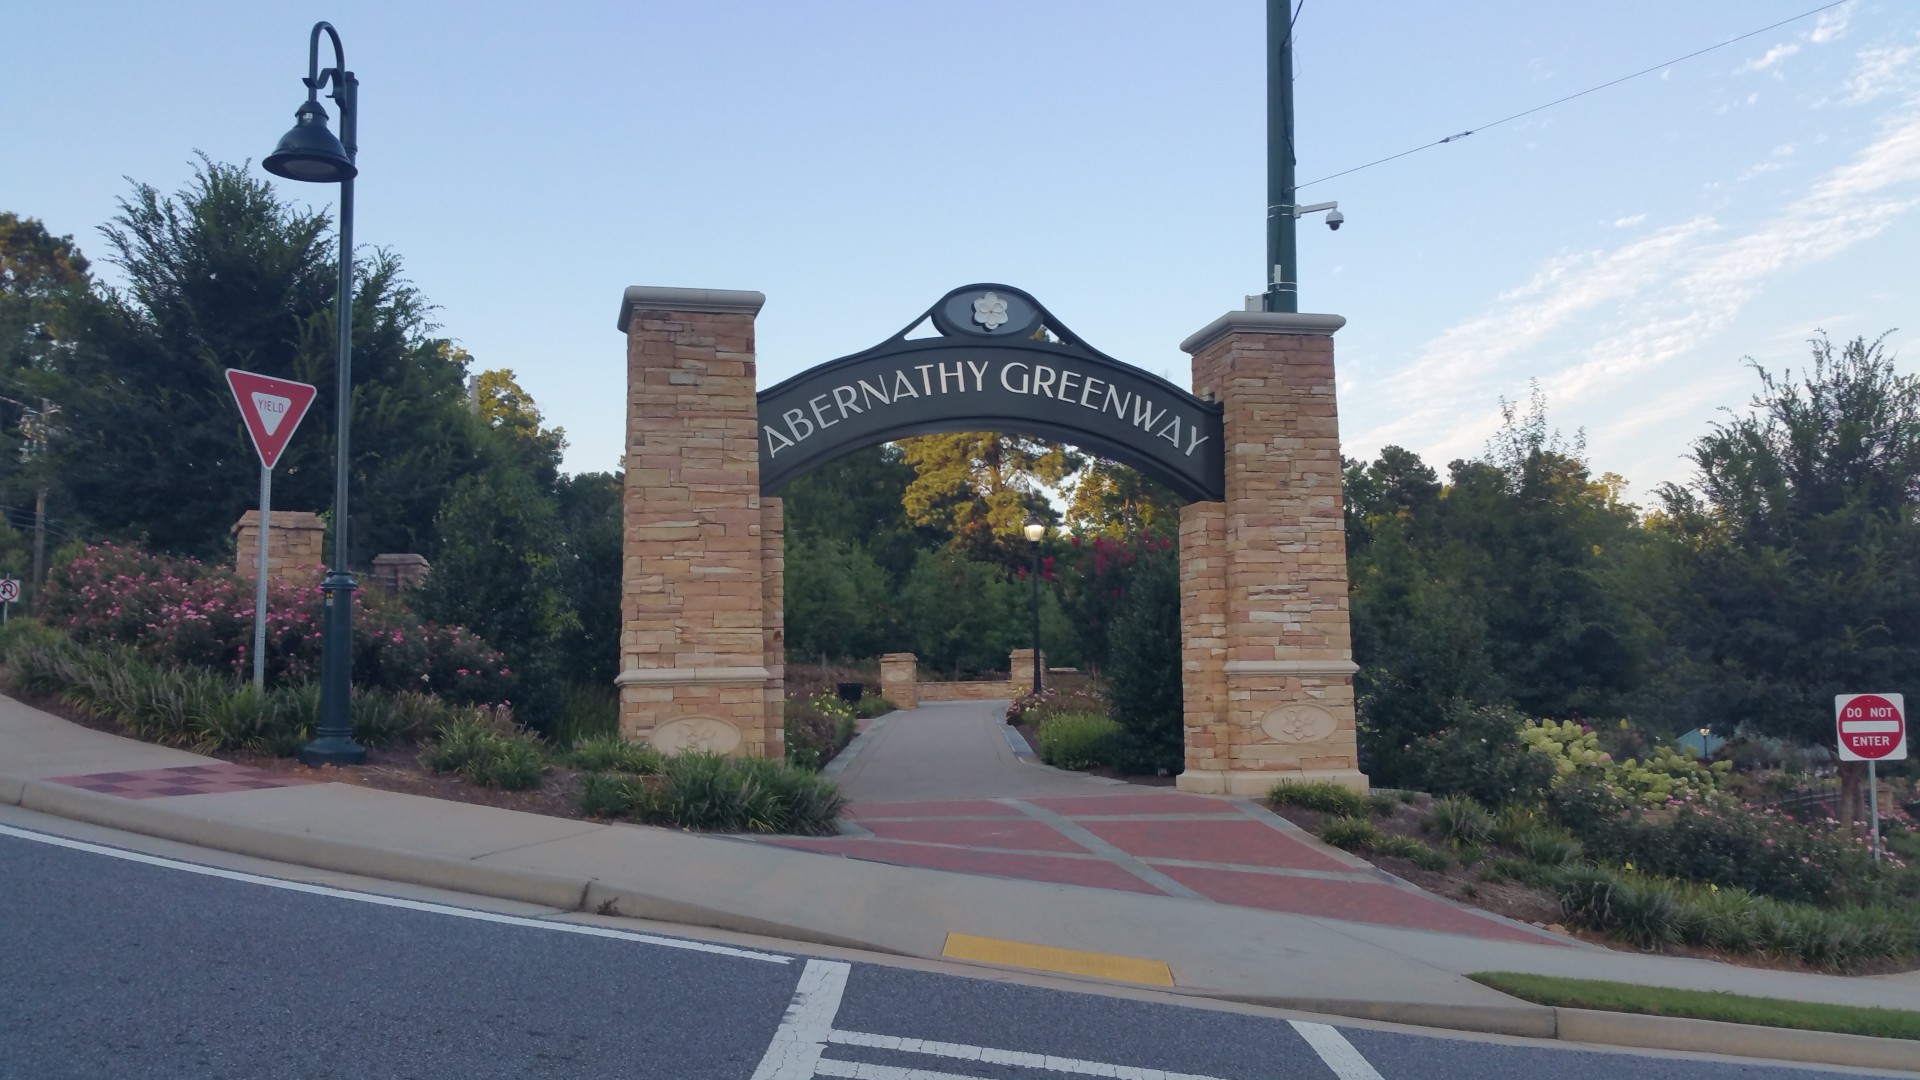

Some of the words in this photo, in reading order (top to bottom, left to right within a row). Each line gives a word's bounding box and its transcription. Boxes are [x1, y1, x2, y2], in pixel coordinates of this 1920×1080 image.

[258, 399, 284, 413] YIELD
[763, 361, 989, 459] ABERNATHY
[1000, 362, 1209, 457] GREENWAY
[1846, 707, 1862, 718] DO
[1870, 707, 1893, 718] NOT
[1852, 736, 1890, 747] ENTER
